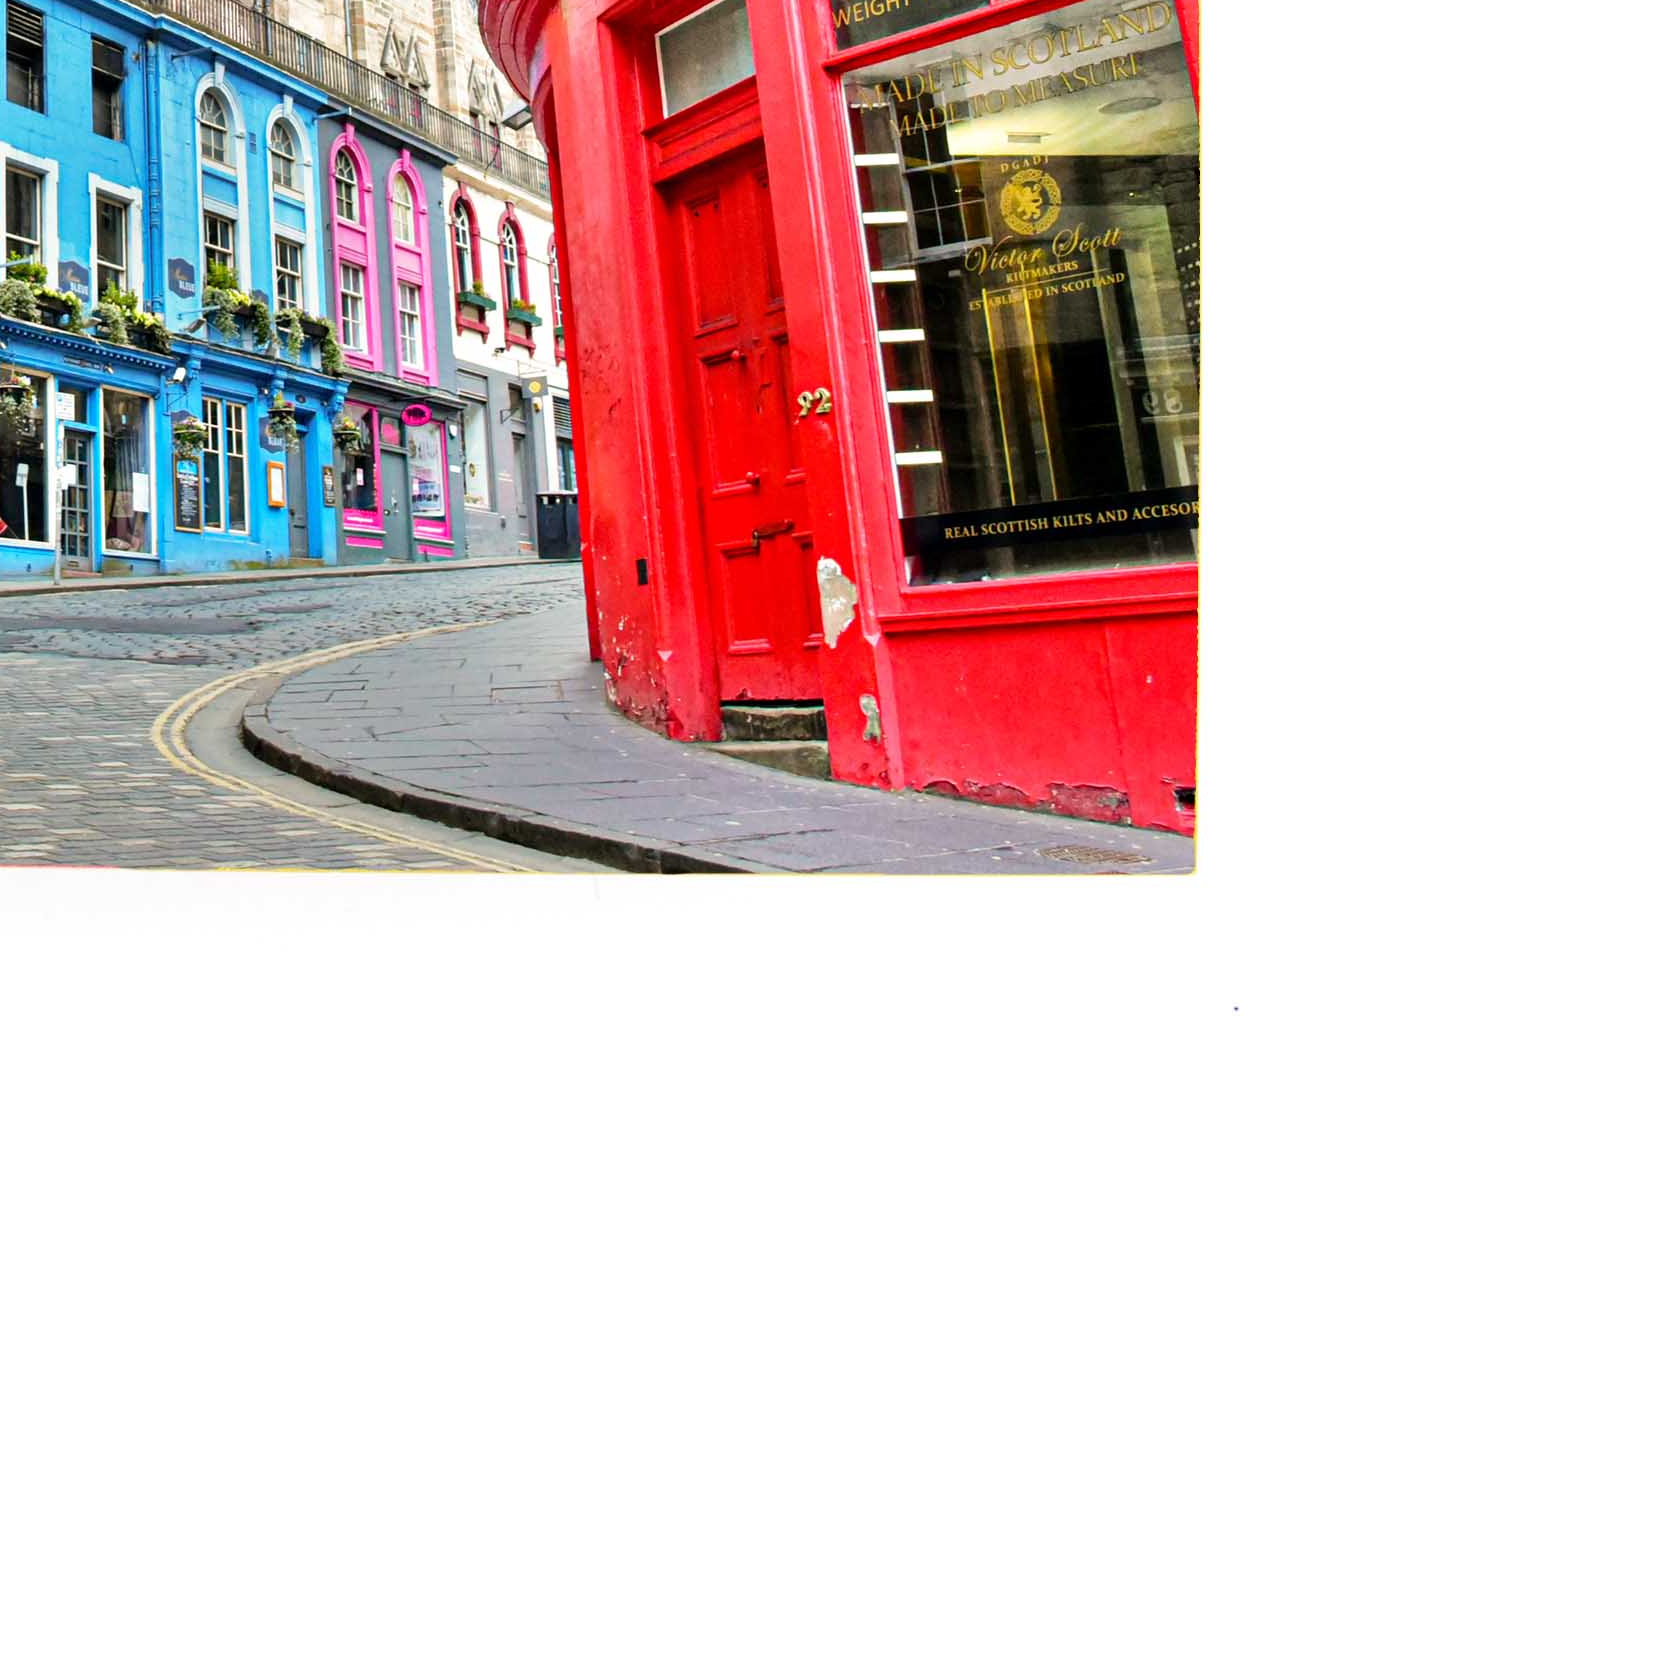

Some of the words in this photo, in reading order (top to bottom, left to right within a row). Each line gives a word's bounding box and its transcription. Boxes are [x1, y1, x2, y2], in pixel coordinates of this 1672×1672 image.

[856, 70, 944, 116] MADE
[951, 53, 984, 88] IN
[991, 0, 1172, 76] SCOTLAND
[889, 104, 967, 137] MADE
[970, 89, 1007, 117] TO
[1013, 52, 1146, 109] MEASURE
[965, 235, 1044, 277] Victor
[1052, 223, 1122, 262] Scott
[968, 289, 1043, 311] ESTABLIED
[1046, 285, 1060, 297] IN
[1062, 272, 1126, 292] SCOTLAND
[1006, 260, 1079, 284] KILTMAKERS
[795, 386, 832, 419] 92
[945, 522, 978, 540] REAL
[981, 518, 1048, 536] SCOTTISH
[1053, 513, 1092, 529] KILTS
[1096, 509, 1128, 524] AND
[1132, 501, 1199, 520] ACCESOR
